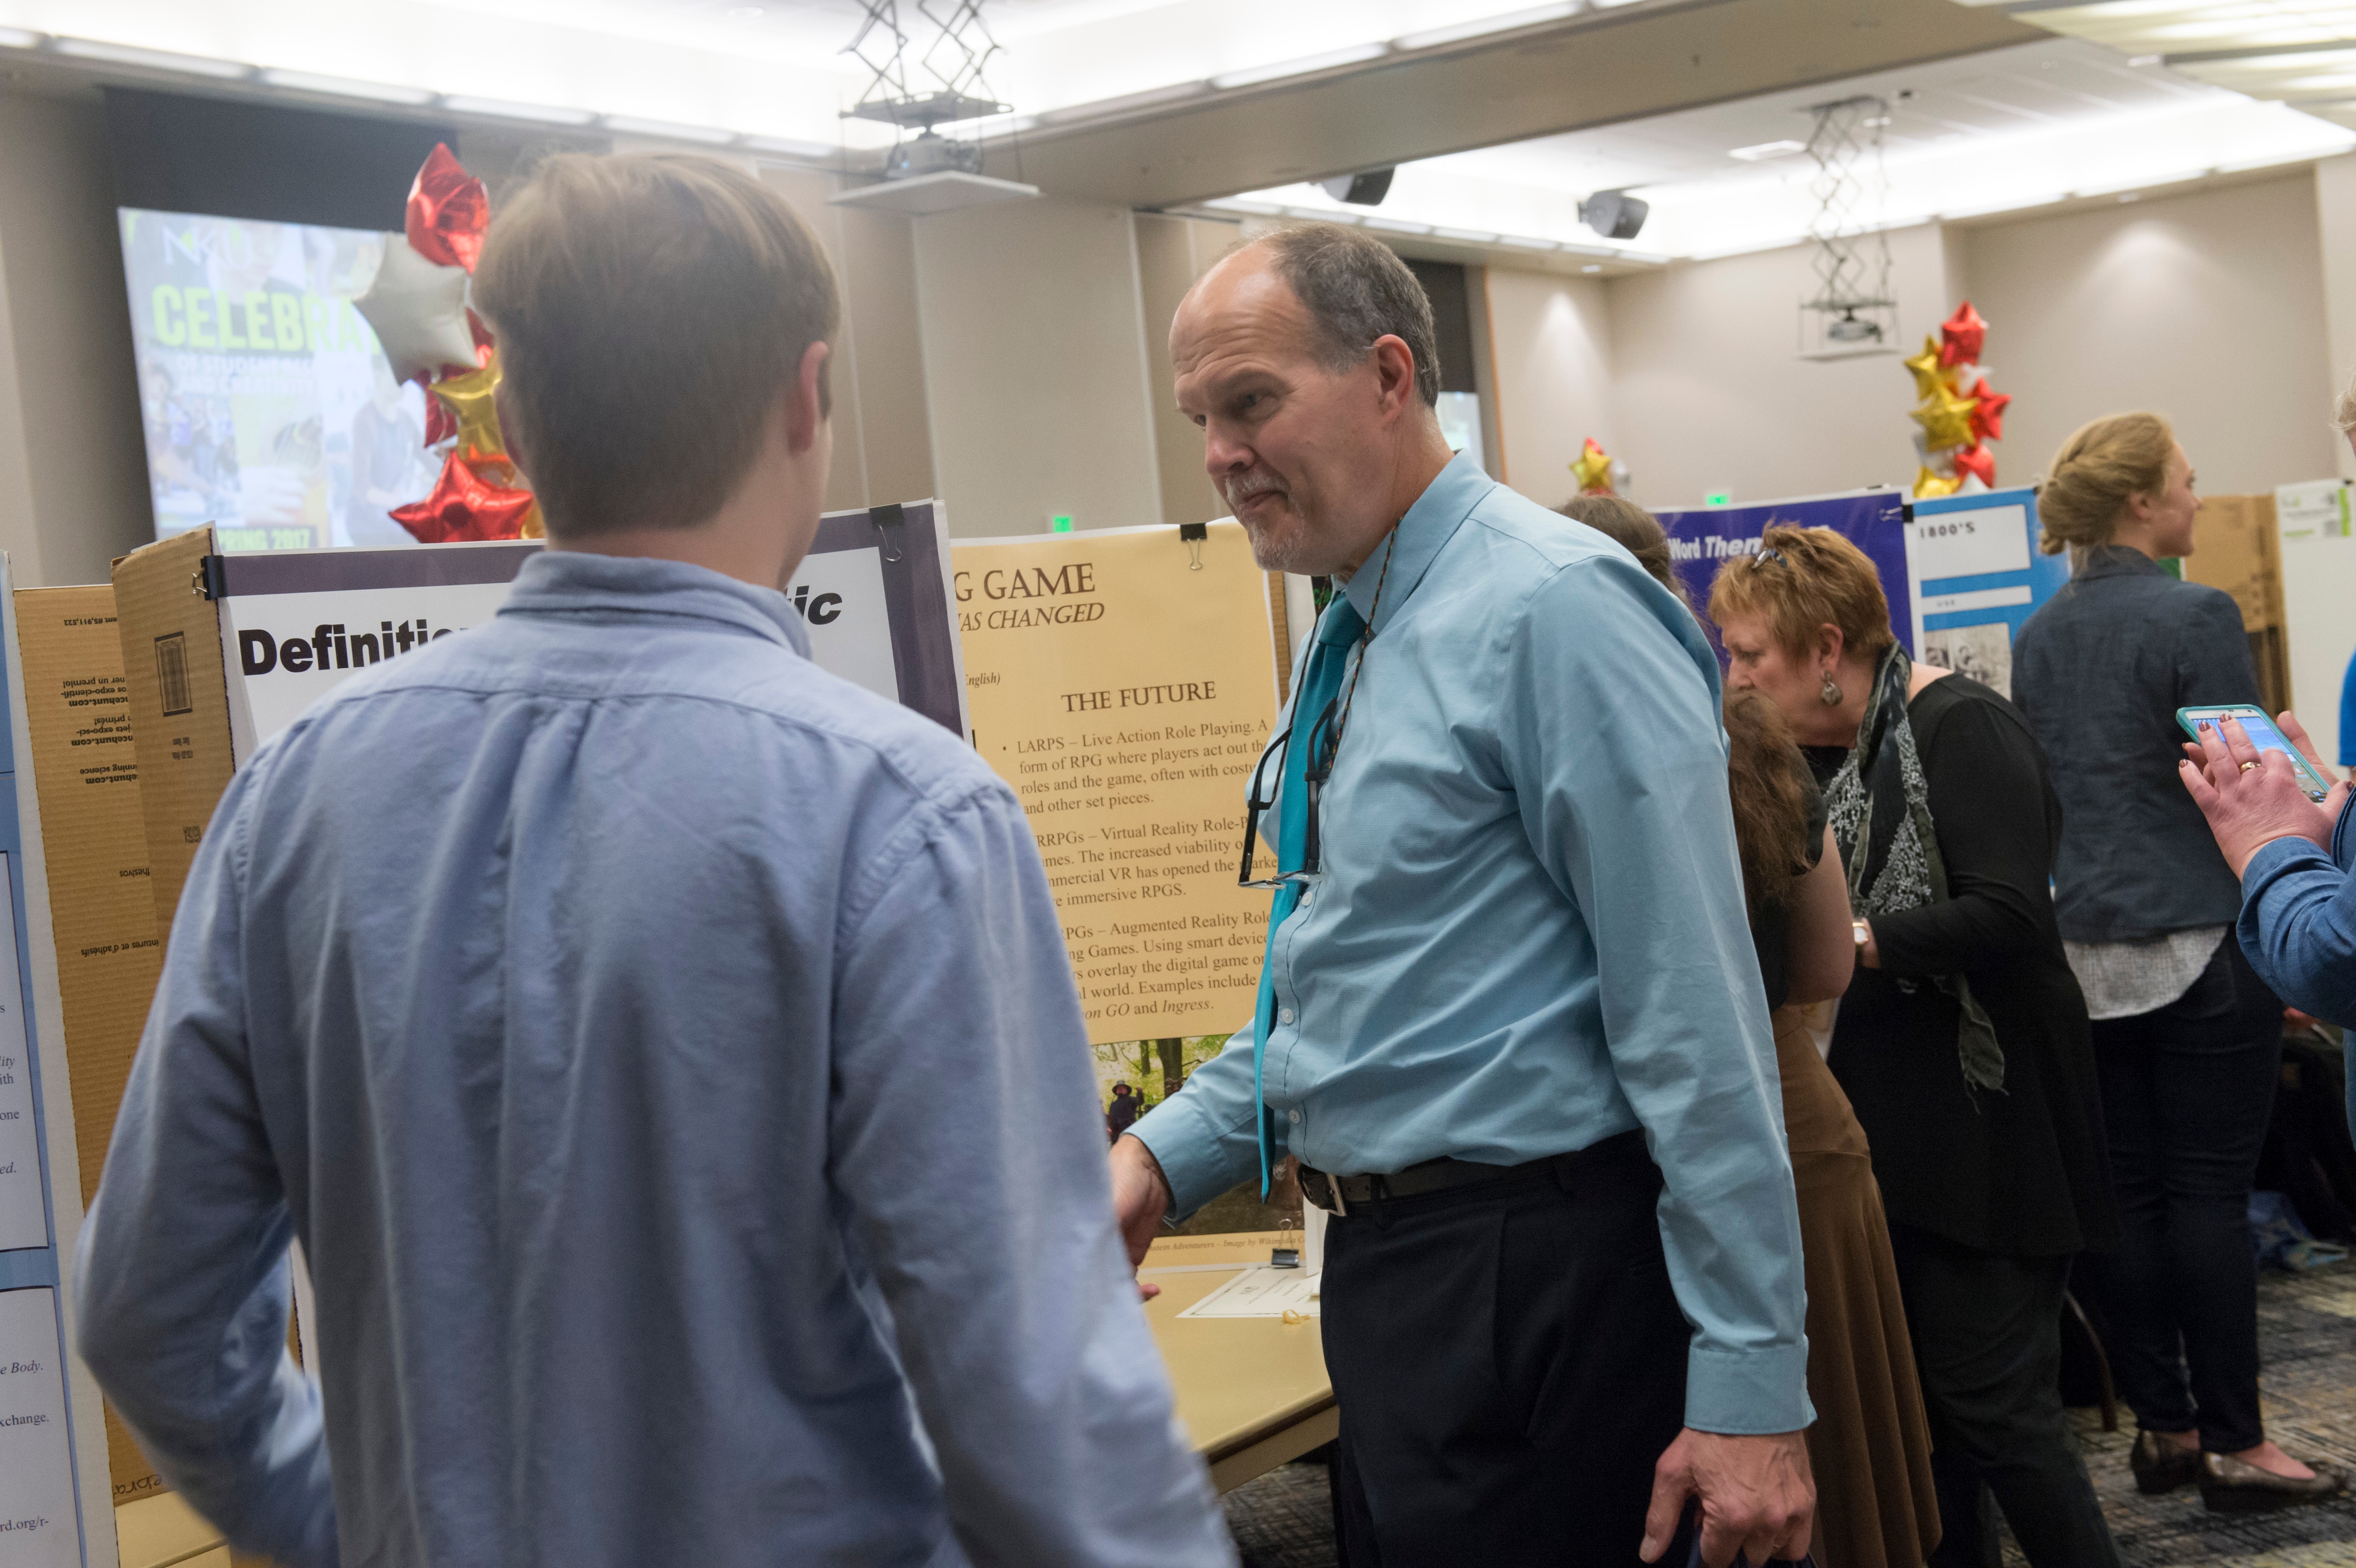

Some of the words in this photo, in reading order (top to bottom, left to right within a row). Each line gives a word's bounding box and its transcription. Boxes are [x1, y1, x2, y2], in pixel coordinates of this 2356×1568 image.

[152, 285, 382, 355] CELEBRA
[954, 571, 973, 602] G
[983, 563, 1095, 600] GAME
[786, 584, 843, 625] ic
[958, 611, 982, 632] AS
[988, 602, 1104, 629] CHANGED
[238, 619, 469, 675] Definiti
[63, 677, 96, 688] premio!
[1061, 691, 1112, 713] THE
[1119, 681, 1216, 707] FUTURE
[76, 726, 113, 737] expo-sci-
[116, 724, 131, 732] jets
[1017, 737, 1065, 753] LARPS
[1082, 733, 1113, 747] Live
[1116, 729, 1160, 744] Action
[1165, 725, 1196, 740] Role
[1200, 721, 1254, 738] Playing.
[1258, 719, 1268, 731] A
[1020, 761, 1048, 774] form
[1052, 757, 1067, 771] of
[1070, 753, 1102, 769] RPG
[1107, 751, 1147, 765] where
[1151, 748, 1199, 765] players
[1203, 745, 1222, 757] act
[1227, 742, 1248, 754] out
[80, 766, 110, 774] science
[86, 773, 138, 784] ehunt.com
[1021, 781, 1050, 795] roles
[1054, 776, 1077, 791] and
[1082, 775, 1102, 788] the
[1107, 773, 1146, 789] game,
[1151, 768, 1185, 782] often
[1189, 764, 1218, 778] with
[1024, 800, 1044, 815] and
[1047, 798, 1081, 812] other
[1086, 795, 1104, 808] set
[1109, 793, 1154, 809] pieces.
[1101, 824, 1146, 840] Virtual
[1151, 821, 1199, 837] Reality
[1078, 849, 1105, 863] The
[1109, 843, 1171, 860] increased
[1176, 839, 1231, 854] viability
[1109, 867, 1132, 881] VR
[1136, 866, 1158, 879] has
[1163, 860, 1210, 879] opened
[1214, 859, 1234, 872] the
[1067, 888, 1137, 905] immersive
[1142, 883, 1186, 898] RPGS.
[1061, 926, 1093, 940] PGs
[1110, 917, 1186, 936] Augmented
[1191, 914, 1239, 929] Reality
[1089, 944, 1139, 958] Games.
[1144, 938, 1183, 954] Using
[1187, 936, 1223, 949] smart
[1088, 962, 1137, 978] overlay
[1142, 960, 1162, 973] the
[1167, 956, 1208, 974] digital
[1213, 956, 1248, 971] game
[1091, 982, 1134, 998] world.
[1139, 978, 1203, 994] Examples
[1208, 973, 1256, 989] include
[1106, 1003, 1130, 1017] GO
[1134, 1000, 1157, 1014] and
[1162, 1000, 1214, 1015] Ingress.
[11, 1360, 43, 1374] Body.
[113, 1474, 162, 1494] ebra
